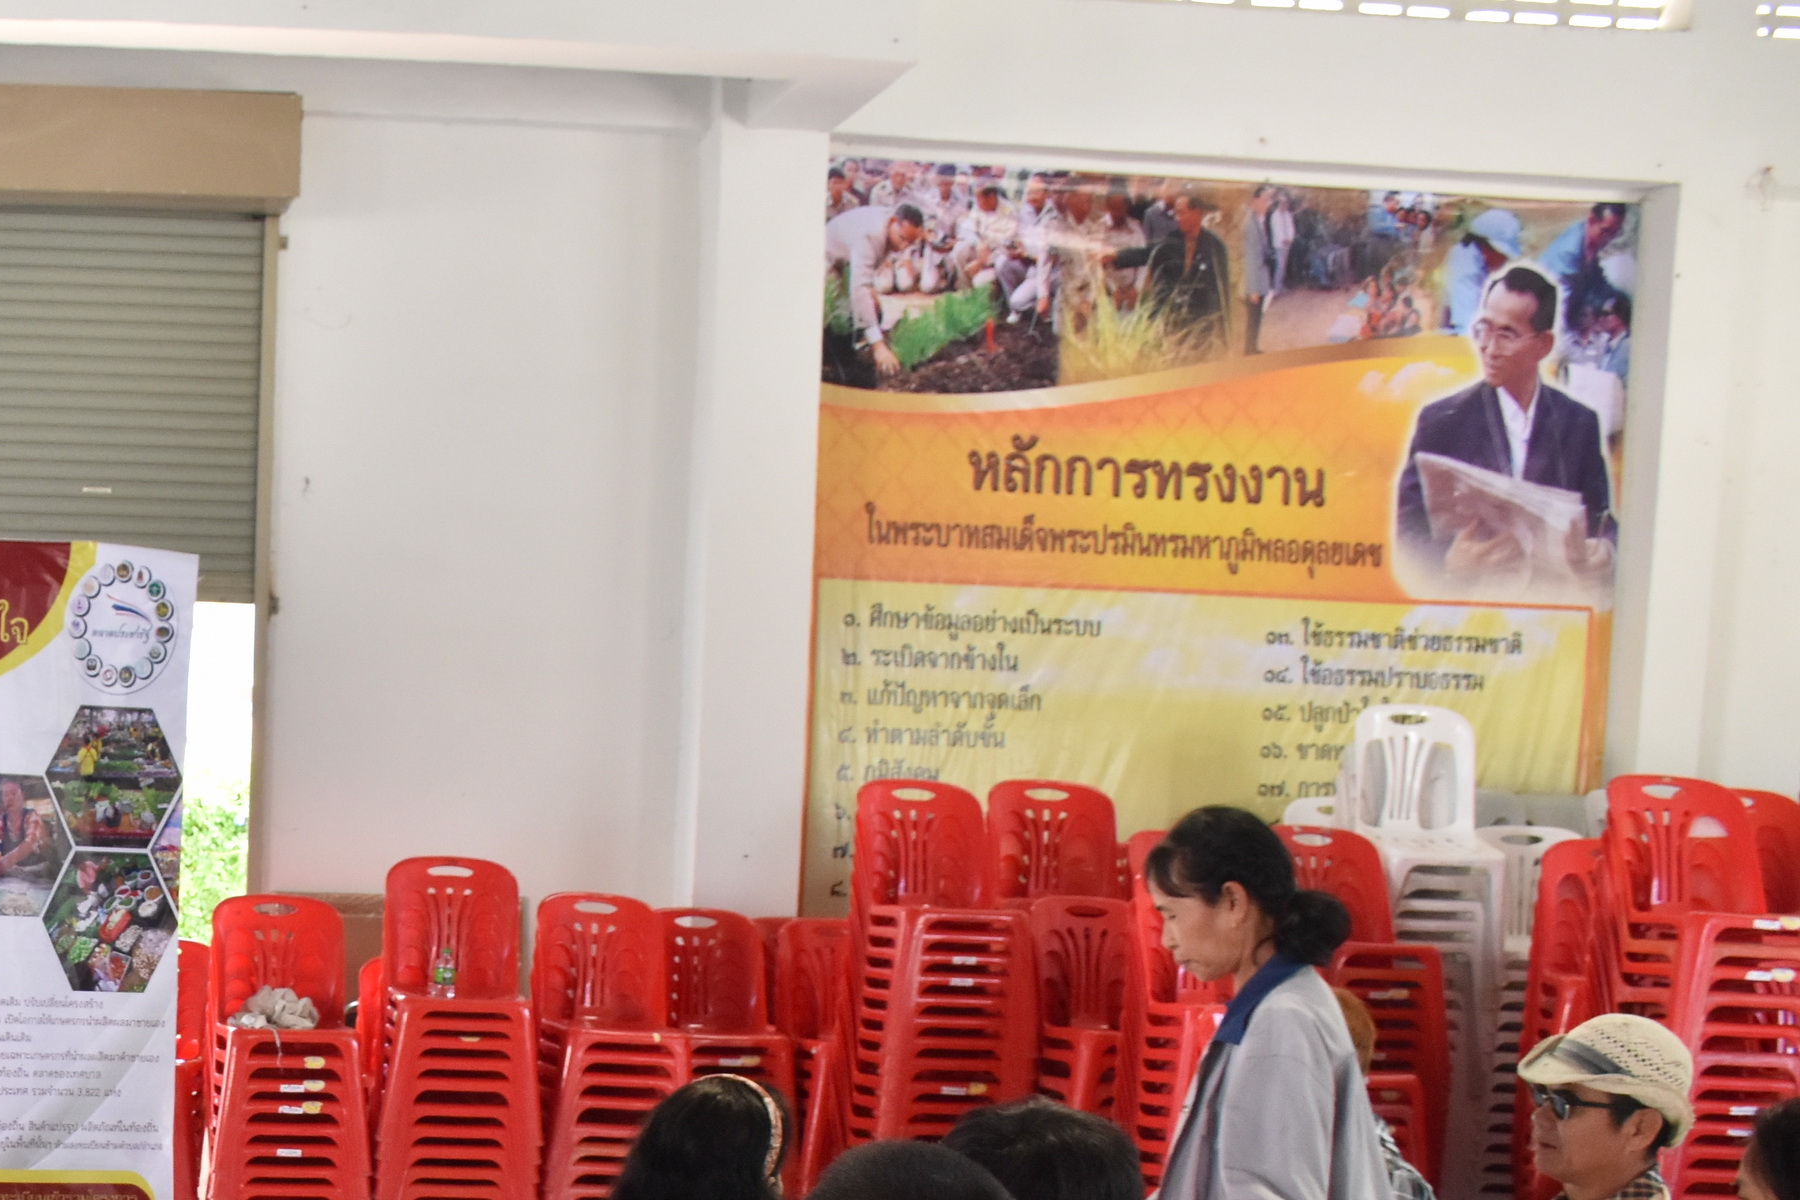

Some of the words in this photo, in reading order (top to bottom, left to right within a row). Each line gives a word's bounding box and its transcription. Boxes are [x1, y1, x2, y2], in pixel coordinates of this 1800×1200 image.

[968, 434, 1326, 507] หลักการทรงงาน
[864, 502, 1383, 578] ในพระบาทสมเด็จพระปรมินทรมหาภูมิพลอดุลยเดช
[869, 603, 1102, 642] ศึกษาข้อมูลอย่างเป็นระบบ
[1301, 616, 1524, 655] ใช้ธรรมชาติช่วยธรรมชาติ
[870, 642, 1019, 673] ระเบิดจากข้างใน
[1299, 655, 1486, 692] ใช้อธรรมปราบอธรรม
[866, 679, 1042, 721] แก้ปัญหาจากจุดเล็ก
[865, 718, 1006, 749] ทำตามลำดับขั้น
